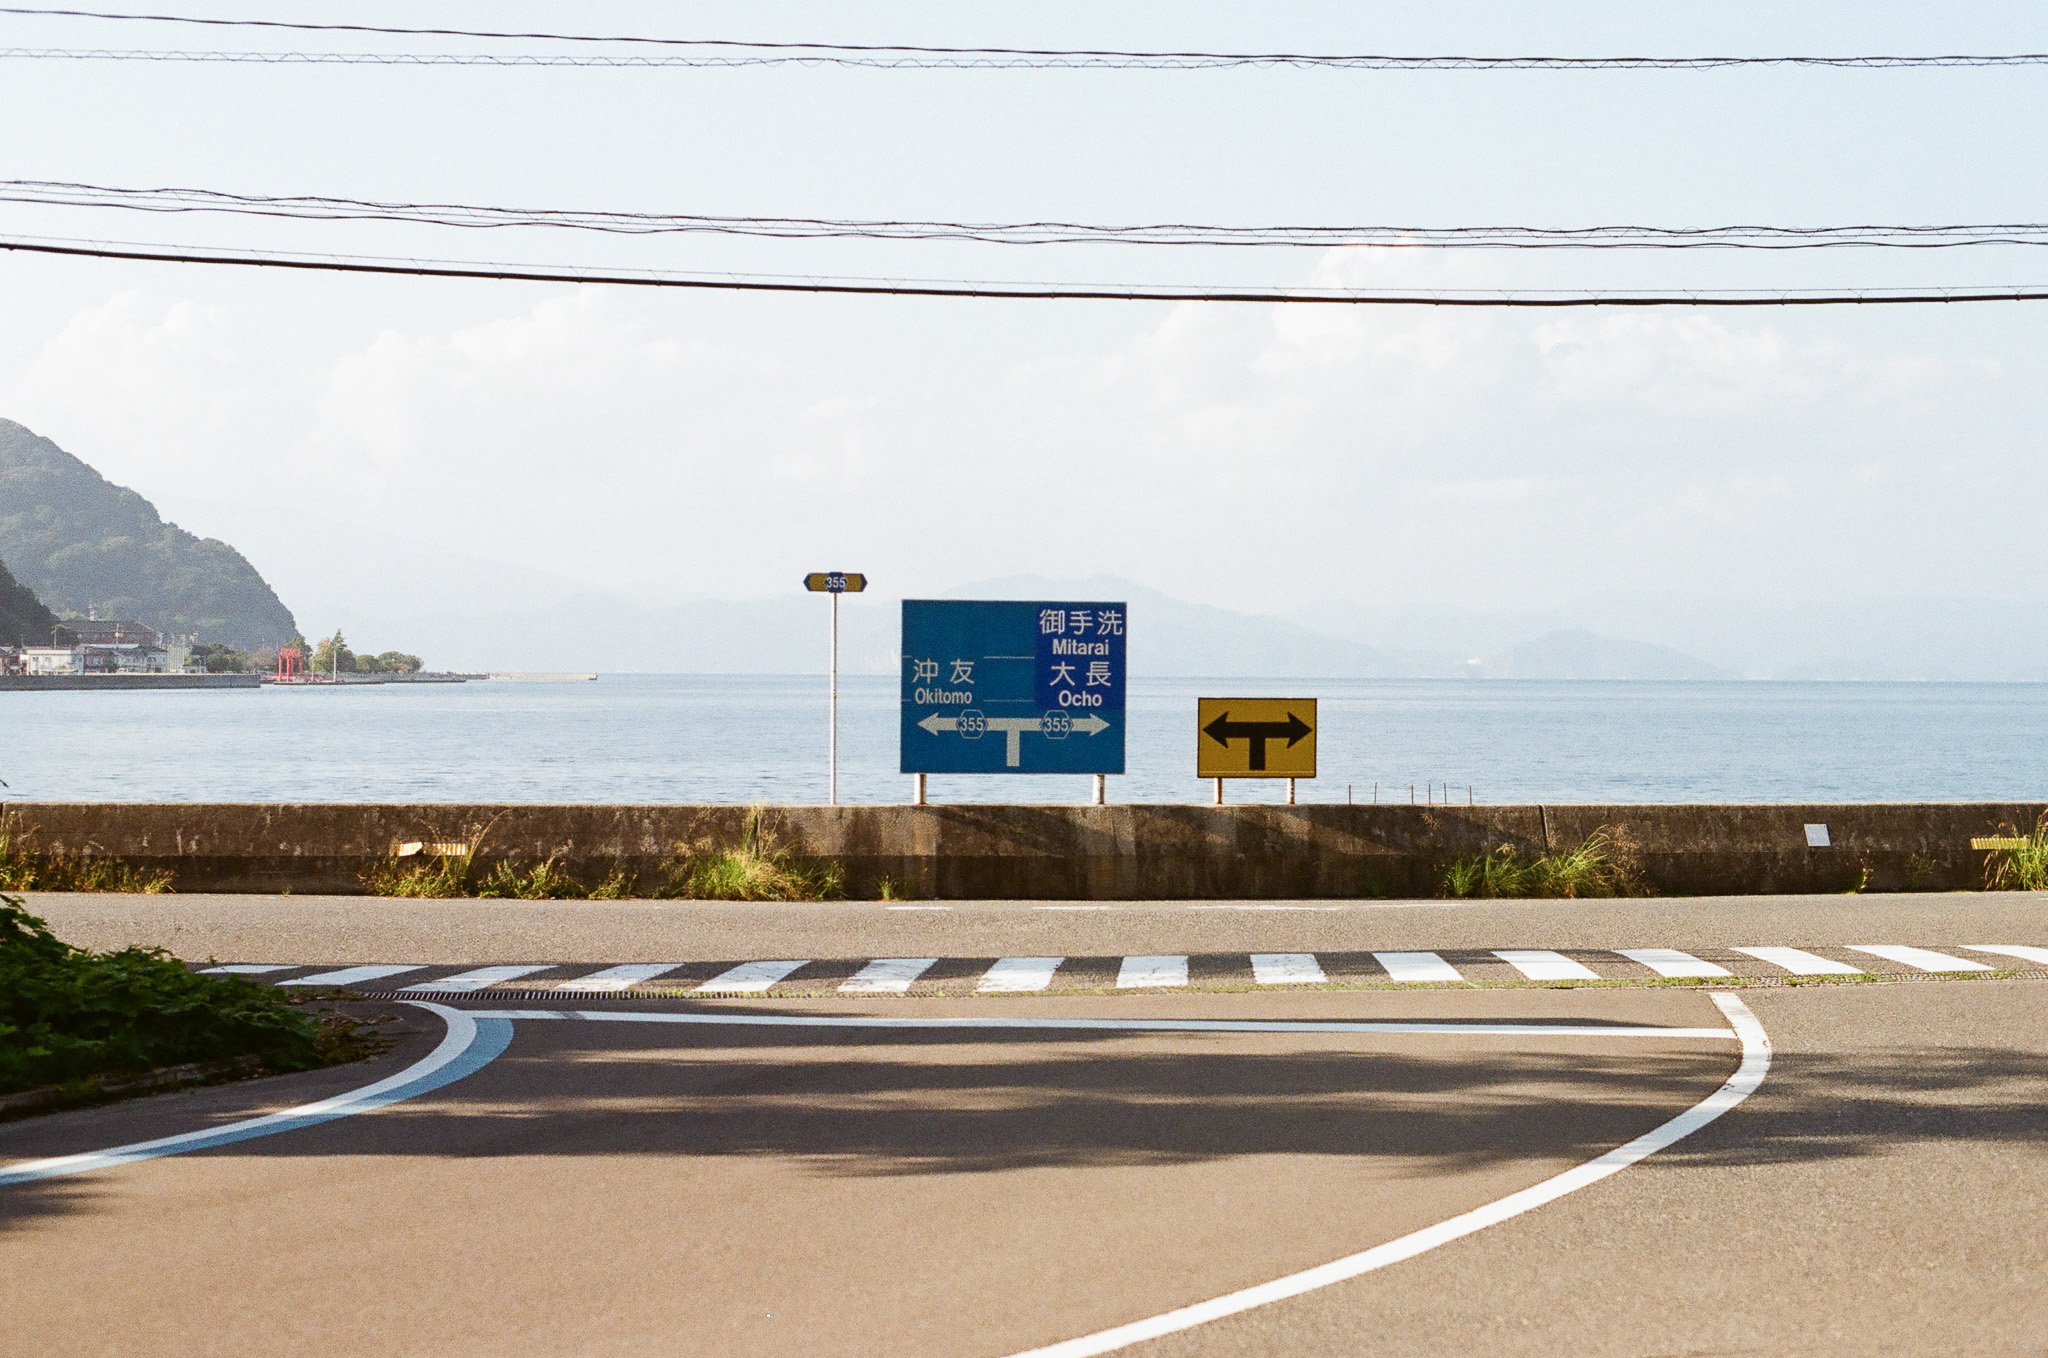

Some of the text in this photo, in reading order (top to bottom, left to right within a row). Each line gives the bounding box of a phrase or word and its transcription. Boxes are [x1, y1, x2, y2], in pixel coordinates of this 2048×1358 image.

[825, 577, 846, 588] 355
[1040, 609, 1123, 635] 御手洗
[1052, 639, 1109, 655] Mitarai
[912, 658, 975, 684] 沖友
[1050, 661, 1111, 687] 大長
[915, 688, 972, 704] Okitomo
[1058, 690, 1102, 707] Ocho
[959, 717, 984, 732] 355
[1044, 717, 1069, 732] 355
